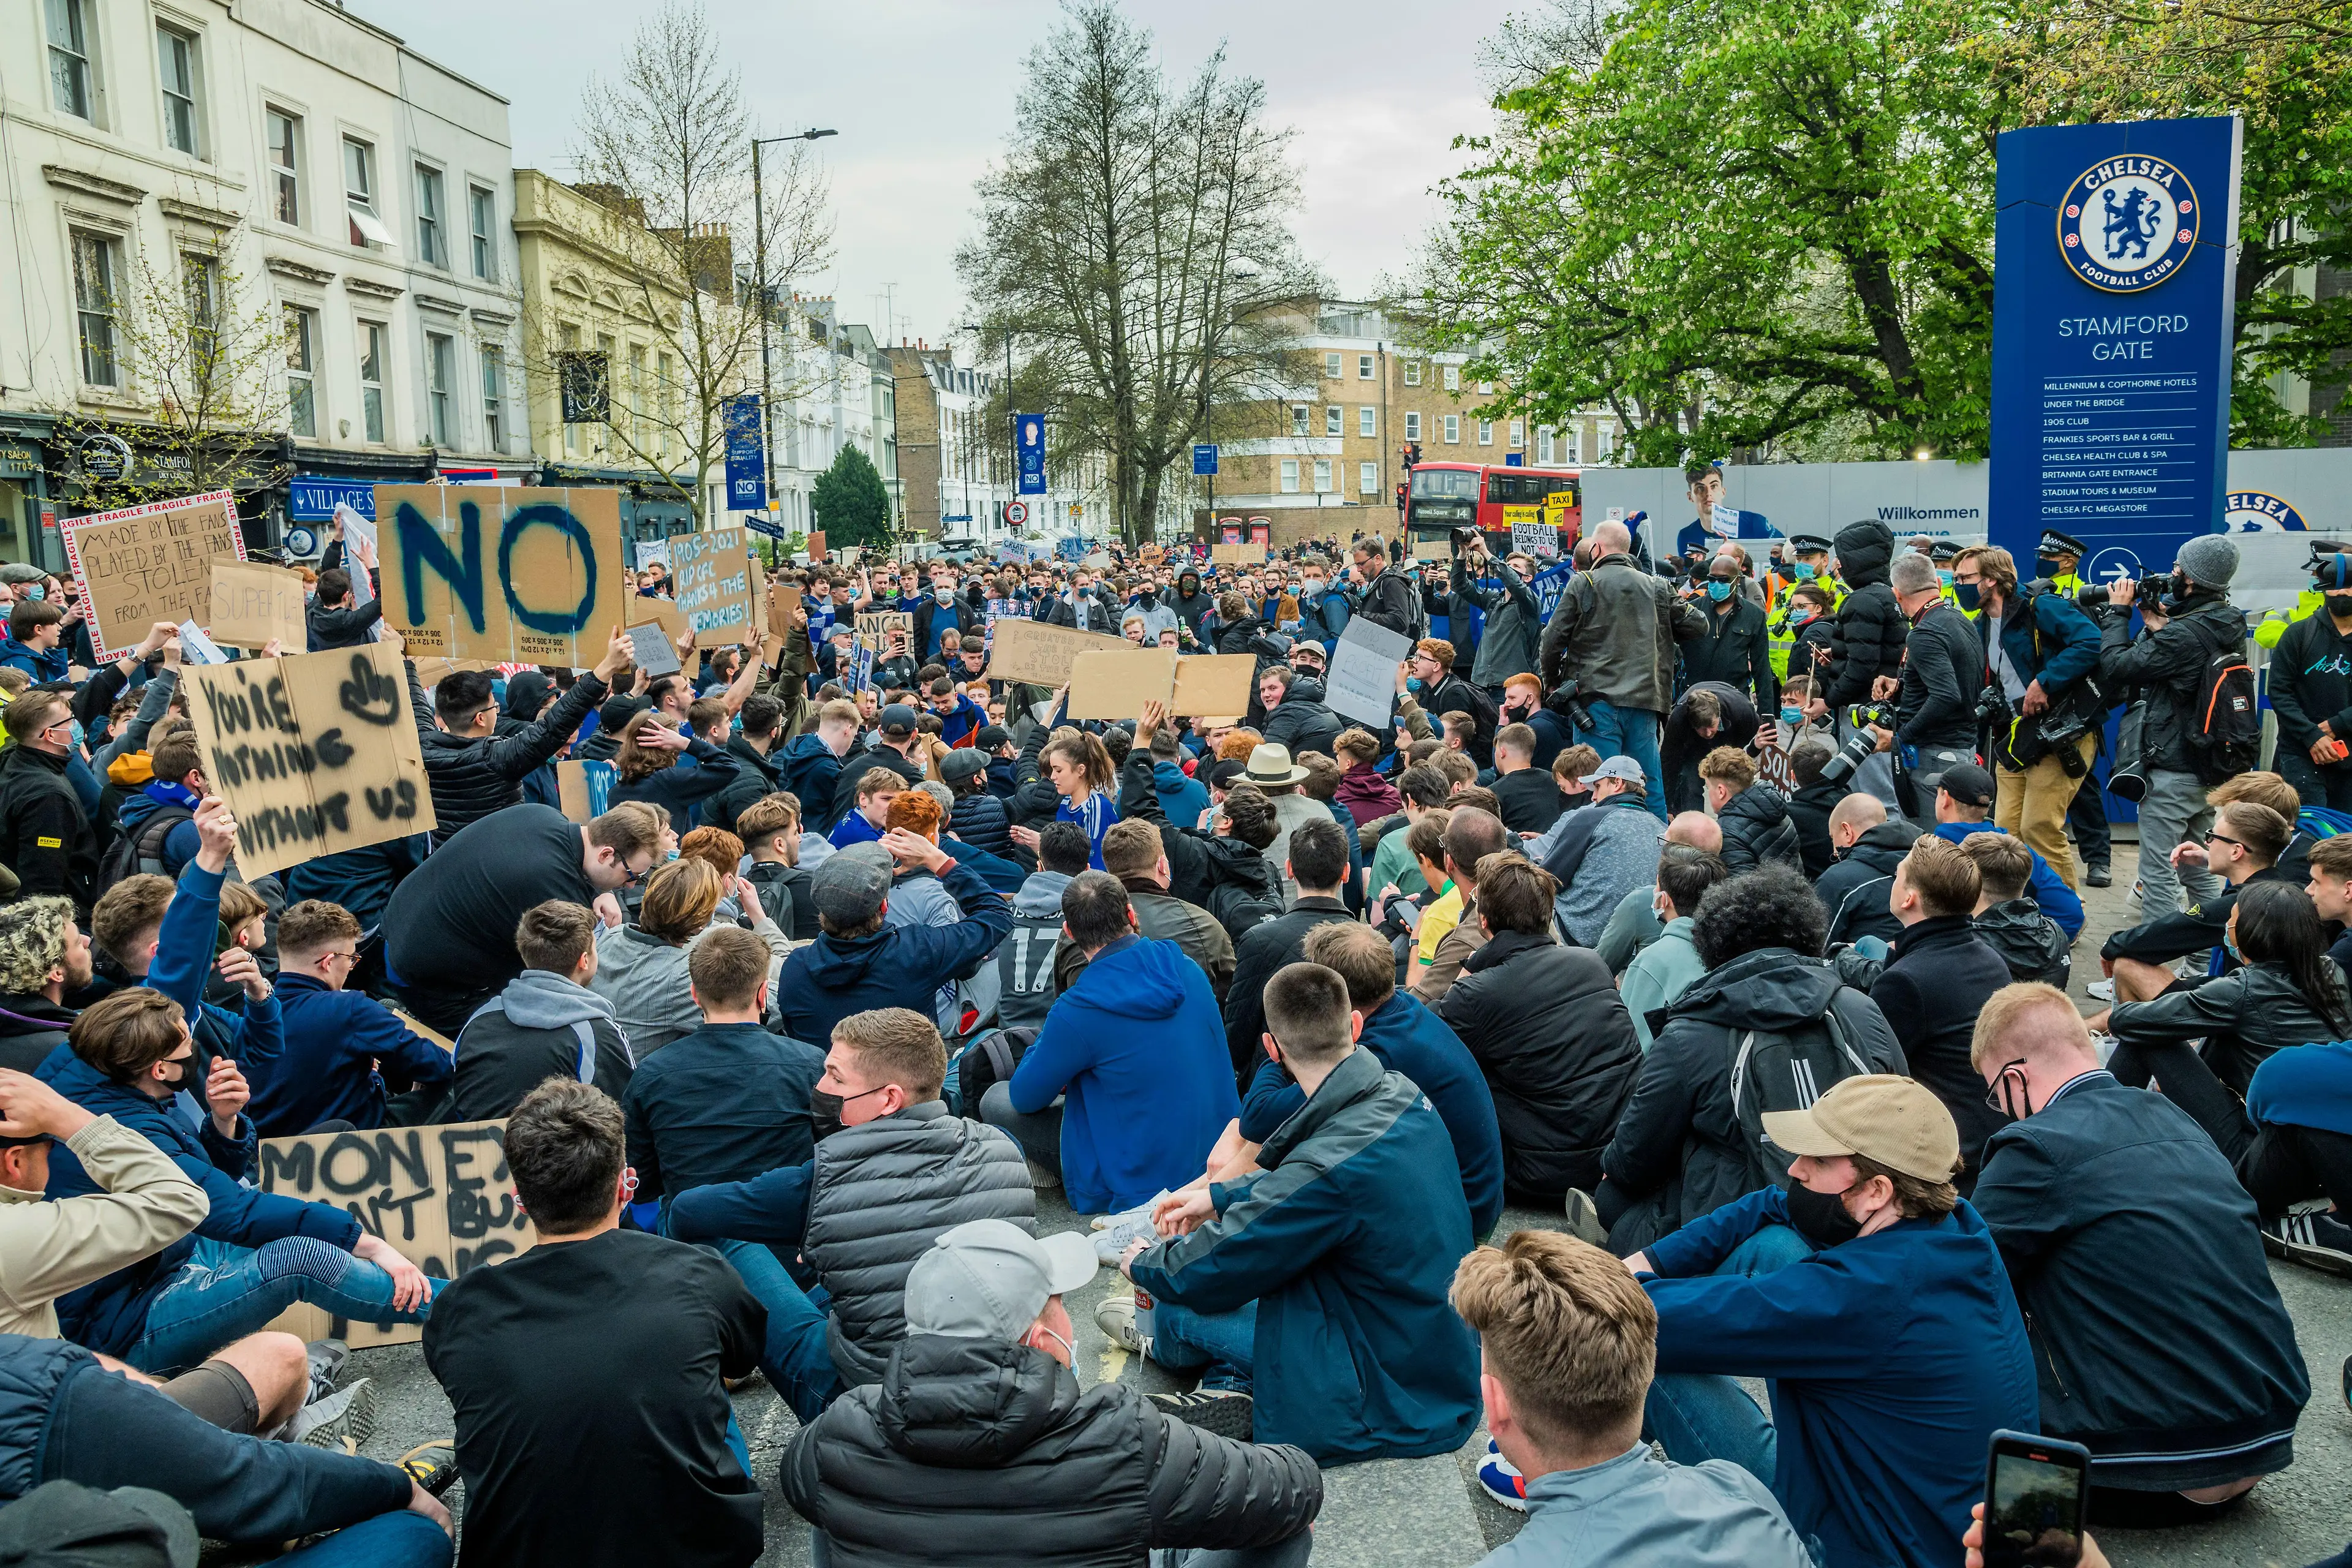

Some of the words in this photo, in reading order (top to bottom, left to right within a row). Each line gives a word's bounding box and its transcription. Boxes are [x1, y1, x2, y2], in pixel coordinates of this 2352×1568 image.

[2085, 159, 2175, 189] CHELSEA
[2081, 262, 2139, 285] FOOTBALL
[2144, 258, 2173, 281] CLUB
[2059, 315, 2188, 337] STAMFORD
[2092, 341, 2153, 361] GATE
[2044, 382, 2097, 390] MILLENNIUM
[2108, 380, 2161, 388] COPTHORNE
[8, 451, 31, 459] SALON
[737, 481, 755, 492] NO
[306, 489, 364, 510] VILLAGE
[1551, 496, 1570, 505] TAXI
[2096, 504, 2148, 513] MEGASTORE
[2225, 495, 2290, 522] ELSEA
[98, 507, 143, 521] FRAGILE
[148, 499, 192, 513] FRAGILE
[1457, 509, 1468, 518] 14
[1512, 510, 1521, 519] calling
[1525, 510, 1535, 519] calling
[1877, 507, 1980, 520] Willkommen
[82, 525, 141, 553] MADE
[149, 521, 162, 539] BY
[170, 518, 194, 536] THE
[200, 511, 227, 531] FANS
[1513, 523, 1555, 537] FOOTBALL
[1515, 534, 1537, 545] BELONGS
[1548, 537, 1557, 546] US
[66, 530, 81, 575] FRAGILE
[86, 547, 148, 579] PLAYED
[153, 543, 167, 565] BY
[173, 538, 195, 560] THE
[204, 530, 233, 554] FANS
[674, 530, 739, 567] 1905-2021
[1061, 538, 1075, 553] SAY
[1521, 545, 1534, 555] NOT
[1537, 545, 1551, 556] YOU
[1001, 551, 1022, 561] STOLEN
[396, 500, 597, 635] NO
[679, 564, 695, 591] RIP
[697, 560, 716, 581] CFC
[123, 557, 211, 600] STOLEN
[676, 583, 709, 612] THANKS
[709, 582, 717, 600] 4
[720, 571, 746, 595] THE
[77, 579, 96, 625] FRAGILE
[115, 602, 149, 624] FROM
[159, 591, 187, 612] THE
[1923, 597, 1943, 609] Canon
[1024, 631, 1075, 645] CREATED
[1085, 639, 1100, 648] FOR
[1354, 624, 1384, 643] FANS
[635, 646, 664, 660] STOLEN
[1036, 644, 1057, 654] THE
[1363, 644, 1393, 664] OVER
[1040, 664, 1060, 674] THE
[1344, 654, 1387, 684] PROFIT
[211, 727, 355, 790] NOTHING
[230, 791, 349, 857] WITHOUT
[364, 778, 417, 821] US
[1011, 928, 1063, 992] 17
[450, 1190, 530, 1239] BU
